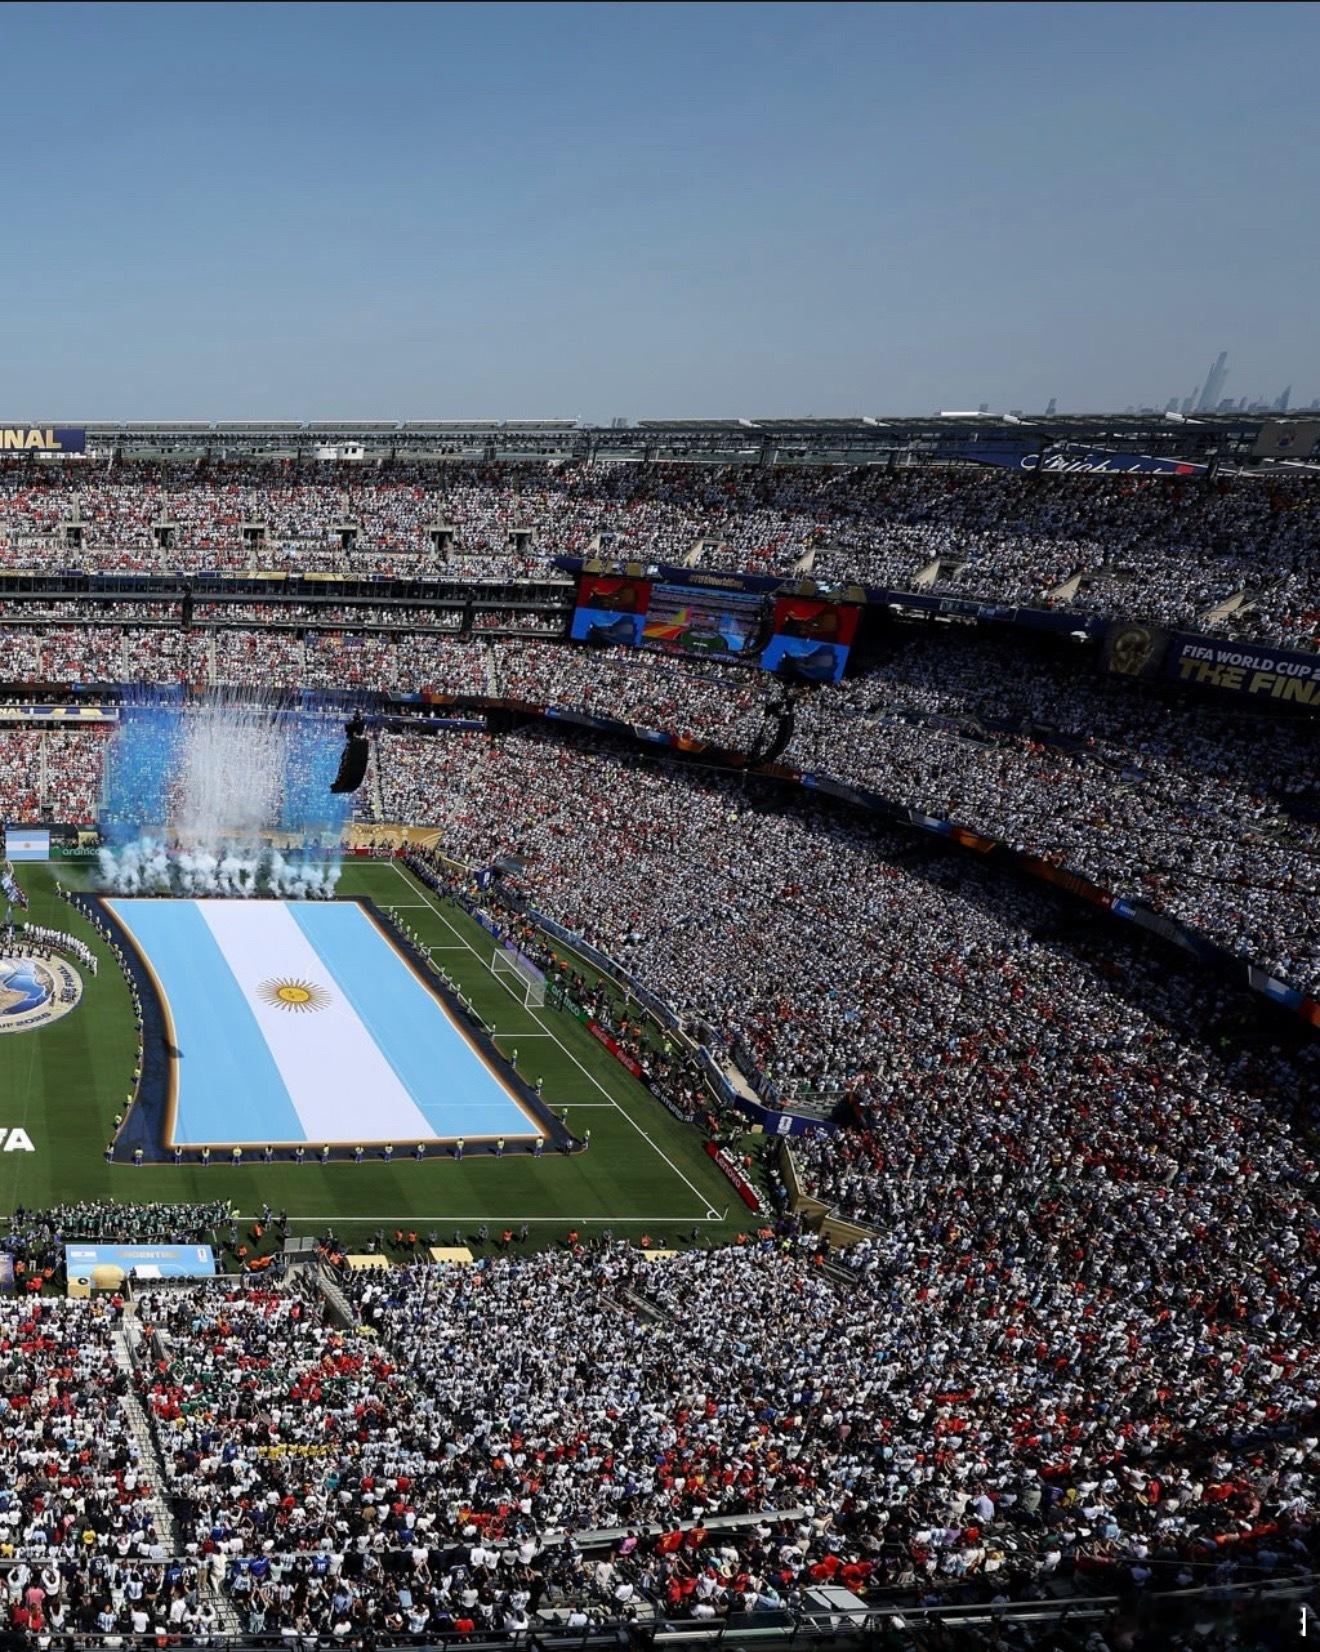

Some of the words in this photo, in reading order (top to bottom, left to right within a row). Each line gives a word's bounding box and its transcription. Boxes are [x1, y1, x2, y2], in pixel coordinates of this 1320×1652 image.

[1179, 657, 1247, 689] THE
[1181, 645, 1213, 661] FIFA
[1216, 650, 1274, 671] WORLD
[1276, 661, 1312, 677] CUP
[62, 848, 100, 857] aramco
[15, 1012, 50, 1026] 2026
[715, 1152, 741, 1188] Lenovo
